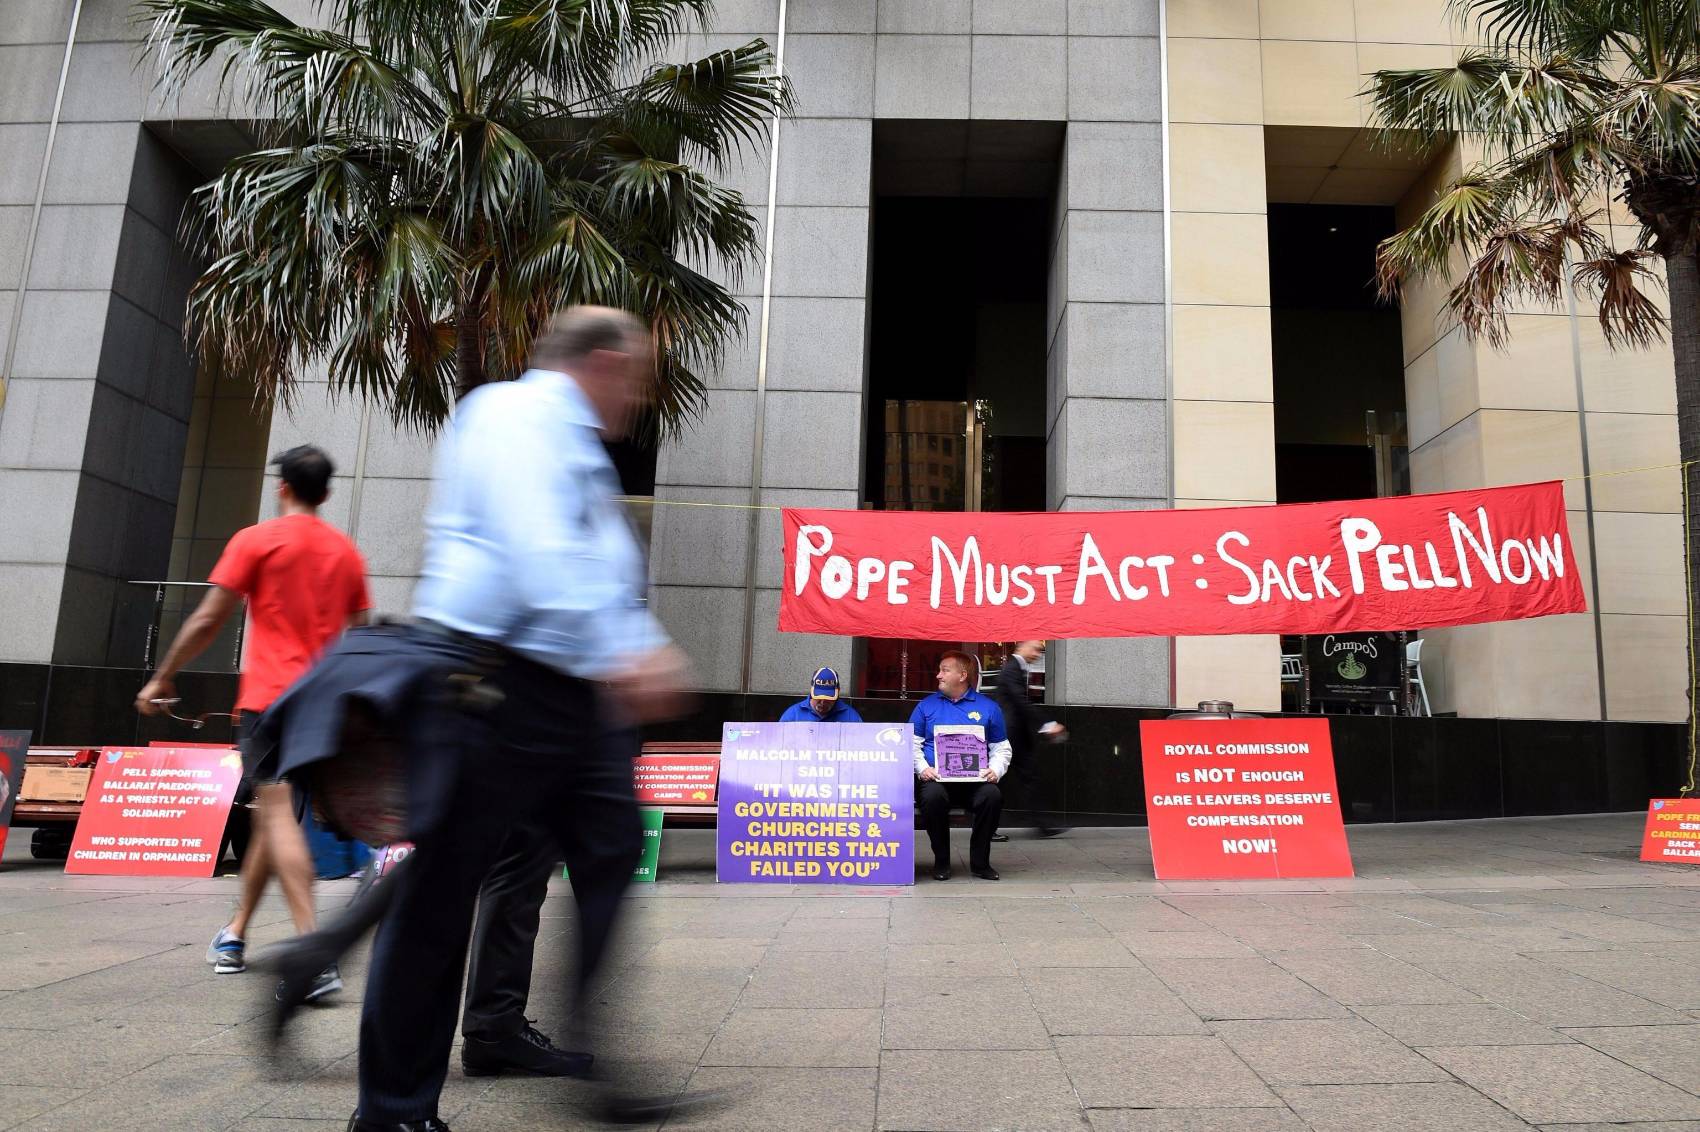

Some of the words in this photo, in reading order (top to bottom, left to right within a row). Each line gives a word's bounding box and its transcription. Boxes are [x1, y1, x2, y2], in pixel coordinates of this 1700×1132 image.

[1073, 532, 1175, 606] ACT
[1447, 507, 1564, 589] NOW
[736, 749, 811, 761] MALCOLM
[815, 750, 898, 762] TURNBULL
[1164, 744, 1213, 756] ROYAL
[1215, 743, 1310, 755] COMMISSION
[122, 768, 147, 777] PELL
[149, 768, 212, 778] SUPPORTED
[797, 766, 835, 777] SAID
[1175, 772, 1190, 783] IS
[1193, 767, 1236, 783] NOT
[1241, 771, 1305, 783] ENOUGH
[103, 781, 156, 790] BALLARAT
[157, 782, 223, 792] PAEDOPHILE
[788, 784, 833, 799] WAS
[838, 784, 879, 799] THE
[100, 795, 113, 803] AS
[116, 795, 124, 803] A
[178, 796, 200, 805] ACT
[202, 797, 218, 806] OF
[1152, 794, 1193, 806] CARE
[1196, 793, 1262, 806] LEAVERS
[1264, 793, 1333, 805] DESERVE
[734, 802, 897, 821] GOVERNMENTS,
[1656, 813, 1684, 821] POPE
[1186, 814, 1304, 827] COMPENSATION
[747, 821, 861, 838] CHURCHES
[866, 823, 882, 838] &
[91, 836, 116, 845] WHO
[117, 837, 180, 847] SUPPORTED
[181, 838, 202, 848] THE
[1222, 838, 1278, 854] NOW!
[1667, 840, 1696, 848] BACK
[74, 851, 127, 860] CHILDREN
[129, 852, 140, 861] IN
[730, 841, 840, 857] CHARITIES
[845, 842, 900, 858] THAT
[750, 861, 821, 877] FAILED
